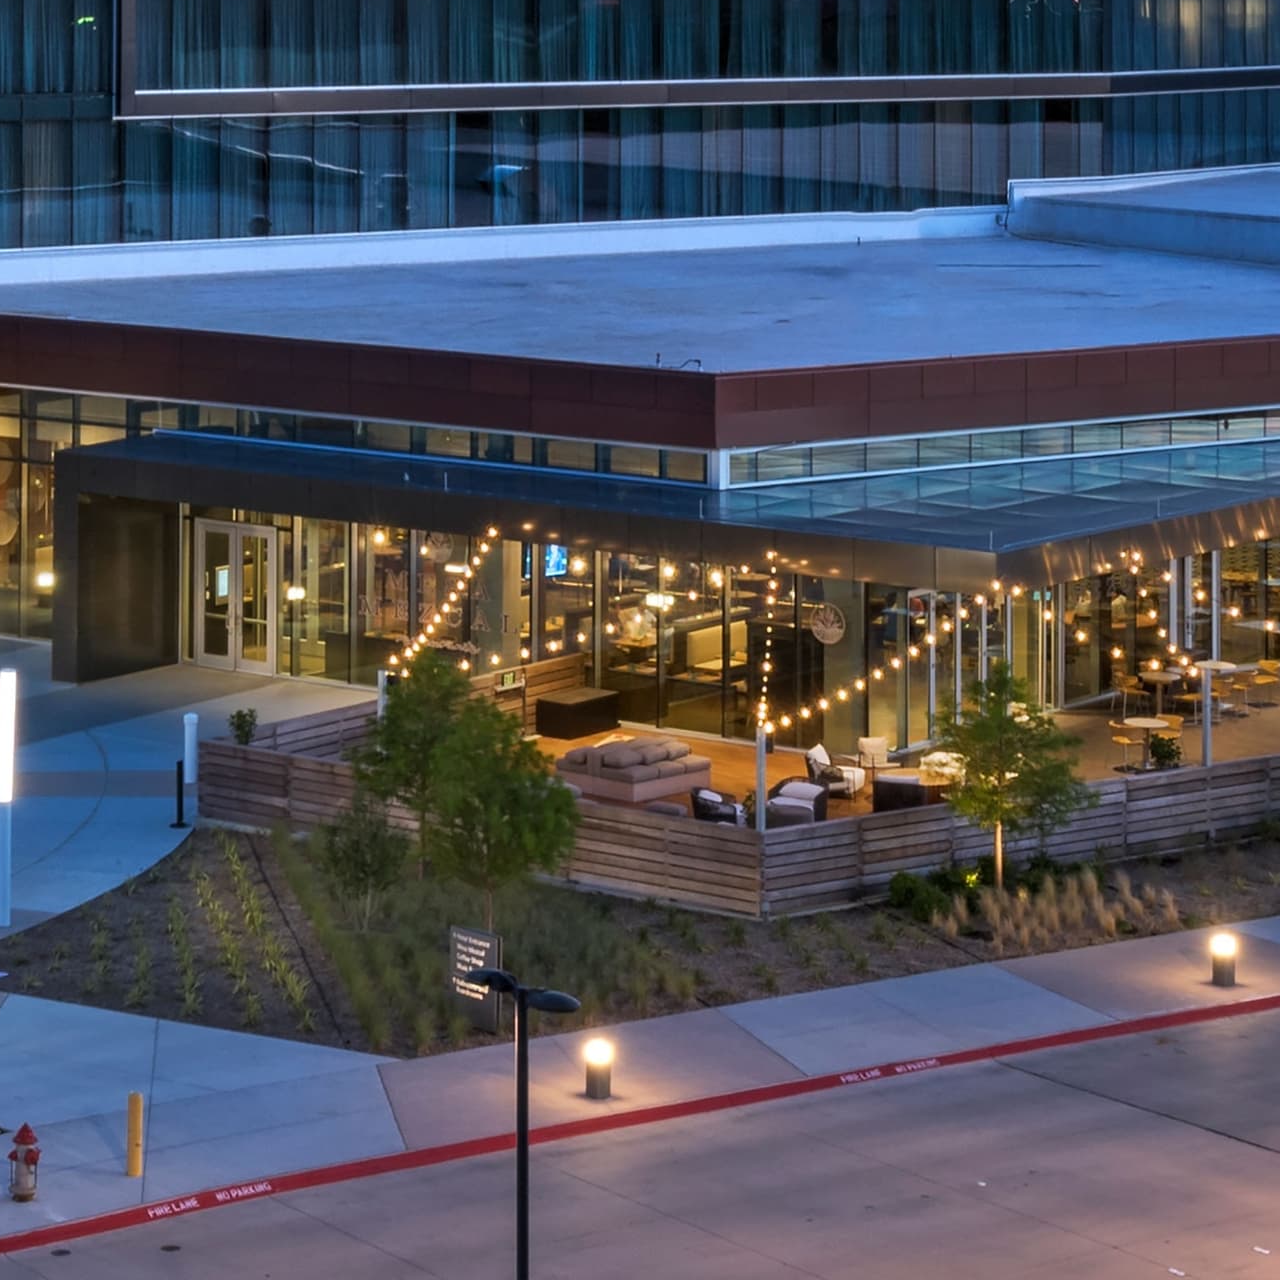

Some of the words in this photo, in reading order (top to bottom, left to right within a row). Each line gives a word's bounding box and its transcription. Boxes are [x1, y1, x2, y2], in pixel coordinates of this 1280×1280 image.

[147, 1206, 172, 1218] FIRE
[171, 1197, 200, 1212] LANE
[215, 1191, 230, 1202] NO
[230, 1182, 272, 1198] PARKING
